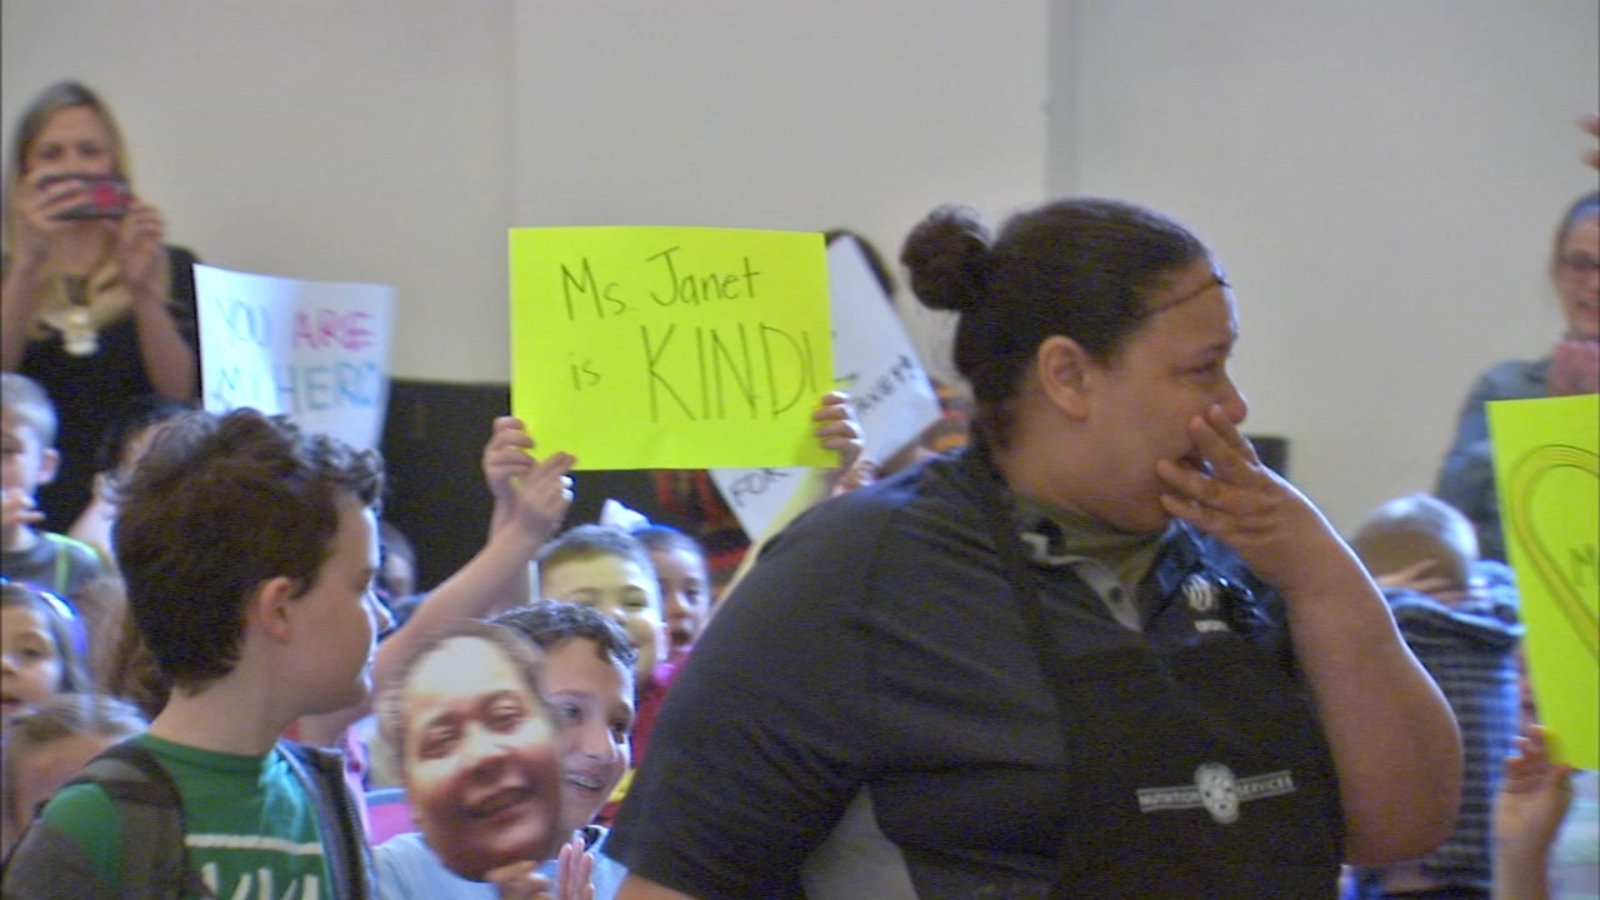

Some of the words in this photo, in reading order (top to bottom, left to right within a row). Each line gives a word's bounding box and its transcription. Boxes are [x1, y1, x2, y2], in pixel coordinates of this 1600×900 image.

[645, 245, 761, 307] Janet
[294, 308, 375, 351] ARE
[568, 351, 601, 390] is
